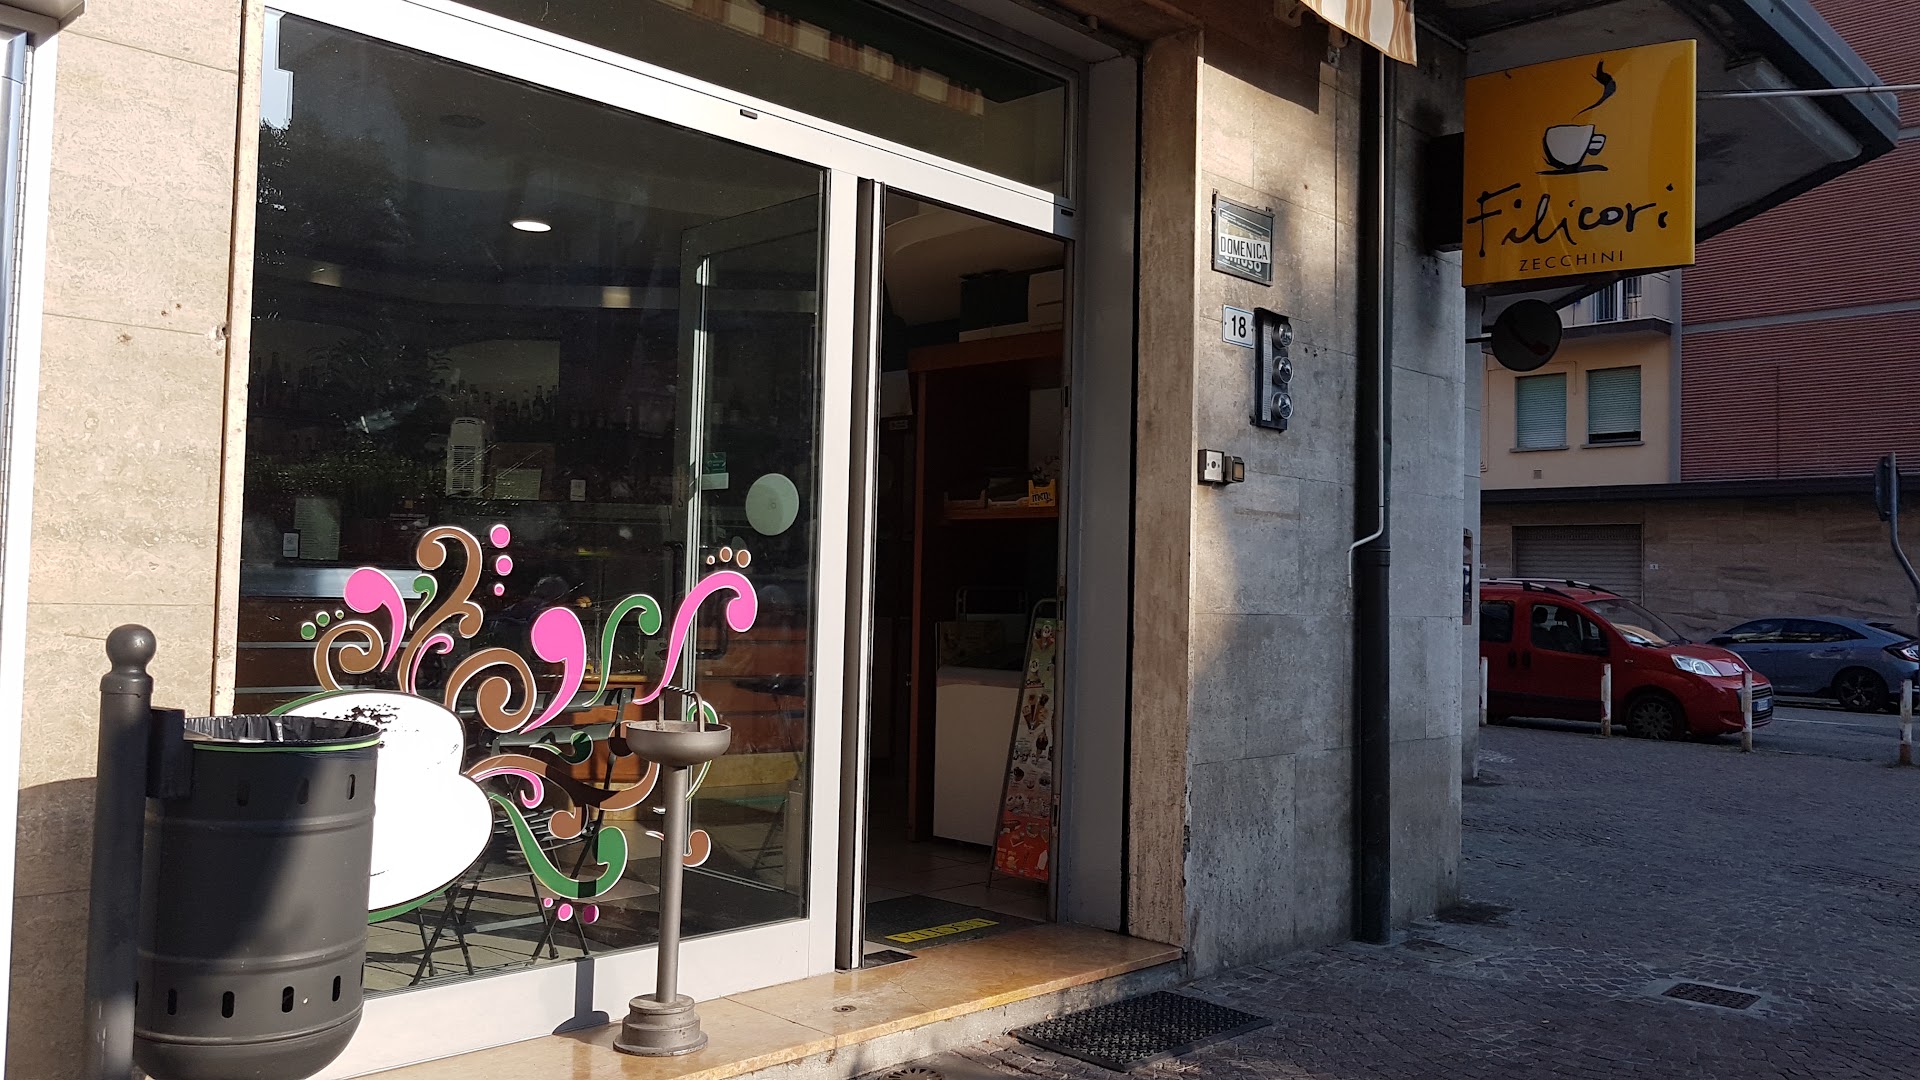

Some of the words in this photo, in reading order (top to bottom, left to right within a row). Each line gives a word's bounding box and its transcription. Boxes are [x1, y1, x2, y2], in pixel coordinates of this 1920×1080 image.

[1466, 182, 1674, 257] Filicori
[1220, 236, 1268, 261] DOMENICA
[1519, 250, 1623, 272] ZECCHINI
[1231, 314, 1247, 338] 18
